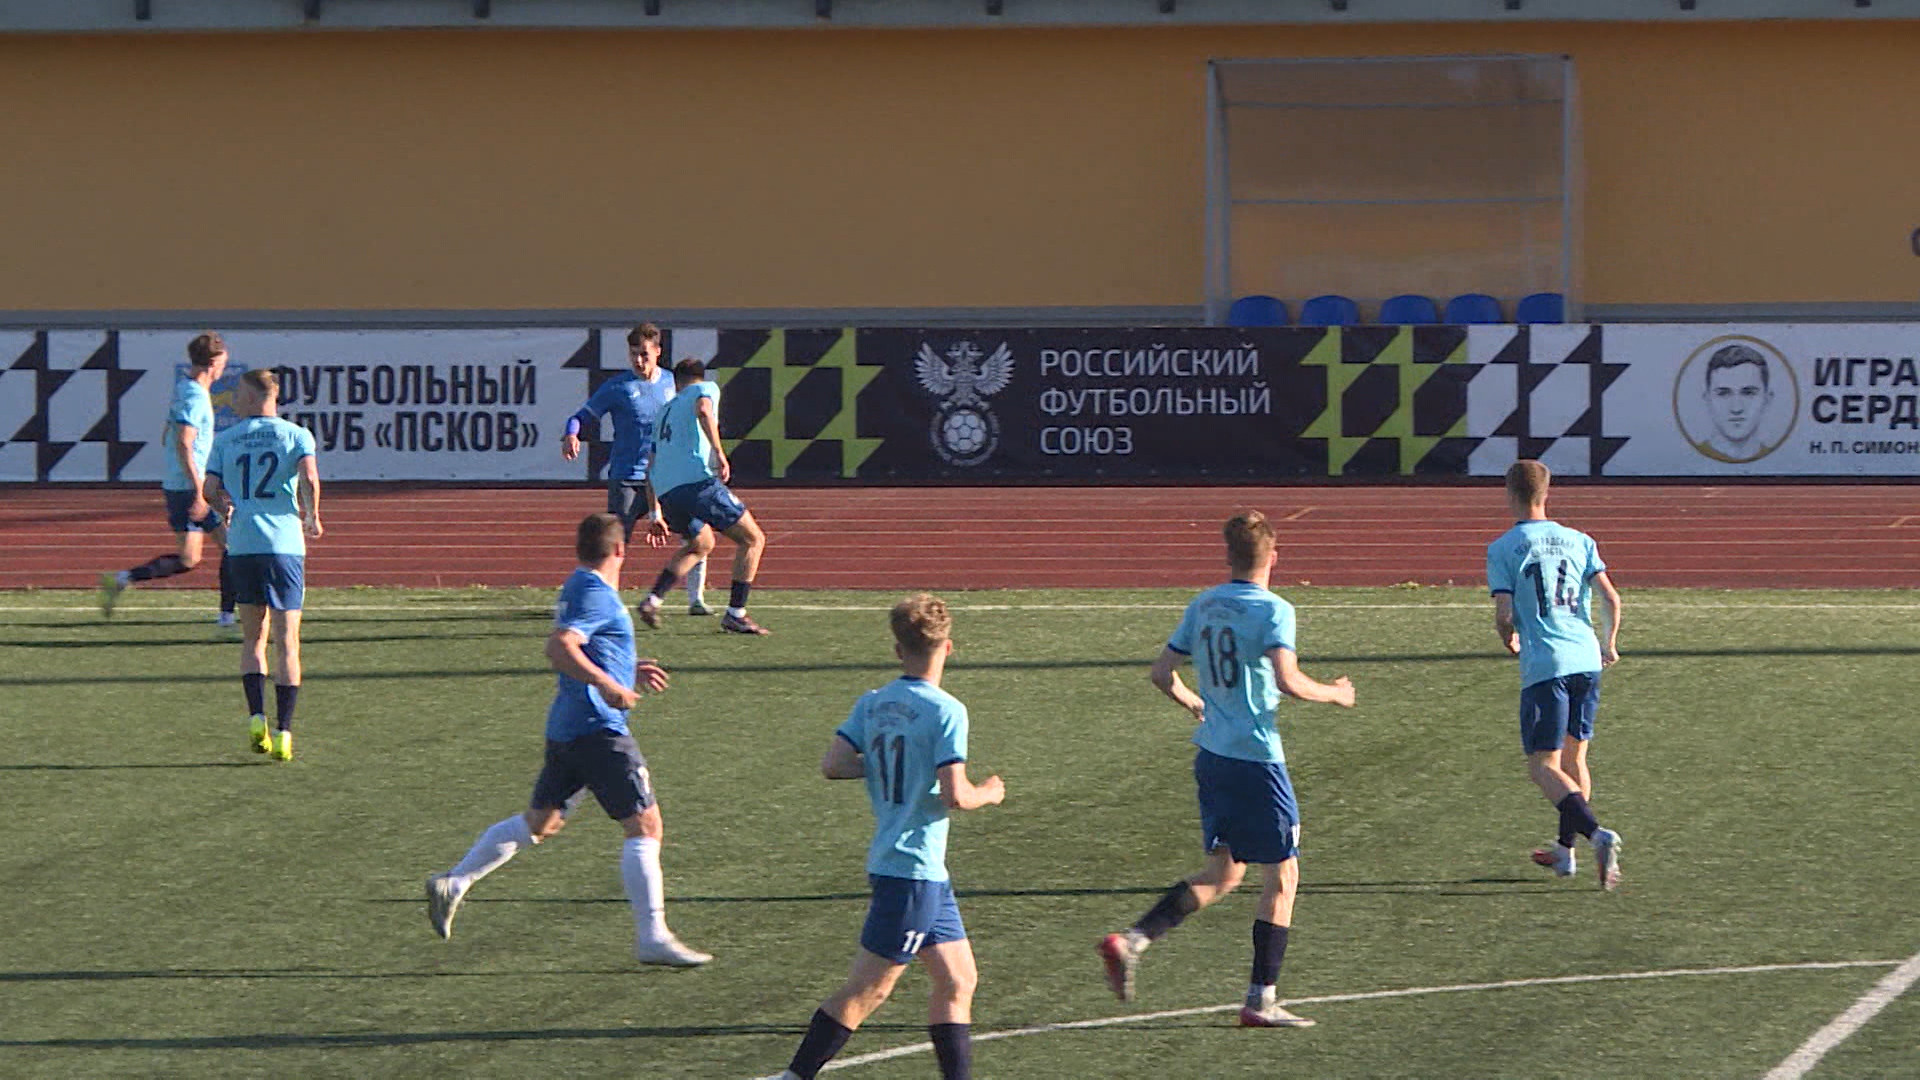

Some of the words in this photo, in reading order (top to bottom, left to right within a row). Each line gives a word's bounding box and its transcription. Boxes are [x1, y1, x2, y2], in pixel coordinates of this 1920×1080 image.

[1040, 343, 1260, 377] РОССИЙСКИЙ
[1814, 357, 1920, 386] ИГРА
[270, 359, 537, 406] ФУТБОЛЬНЫЙ
[1040, 381, 1272, 415] ФУТБОЛЬНЫЙ
[1812, 394, 1920, 430] СЕРД
[279, 411, 366, 452] ЛУБ
[375, 411, 540, 452] «ПСКОВ»
[1040, 426, 1134, 455] СОЮЗ
[236, 451, 279, 500] 12
[1524, 559, 1579, 618] 14
[1201, 625, 1239, 688] 18
[871, 732, 905, 805] 11
[902, 930, 925, 954] 11
